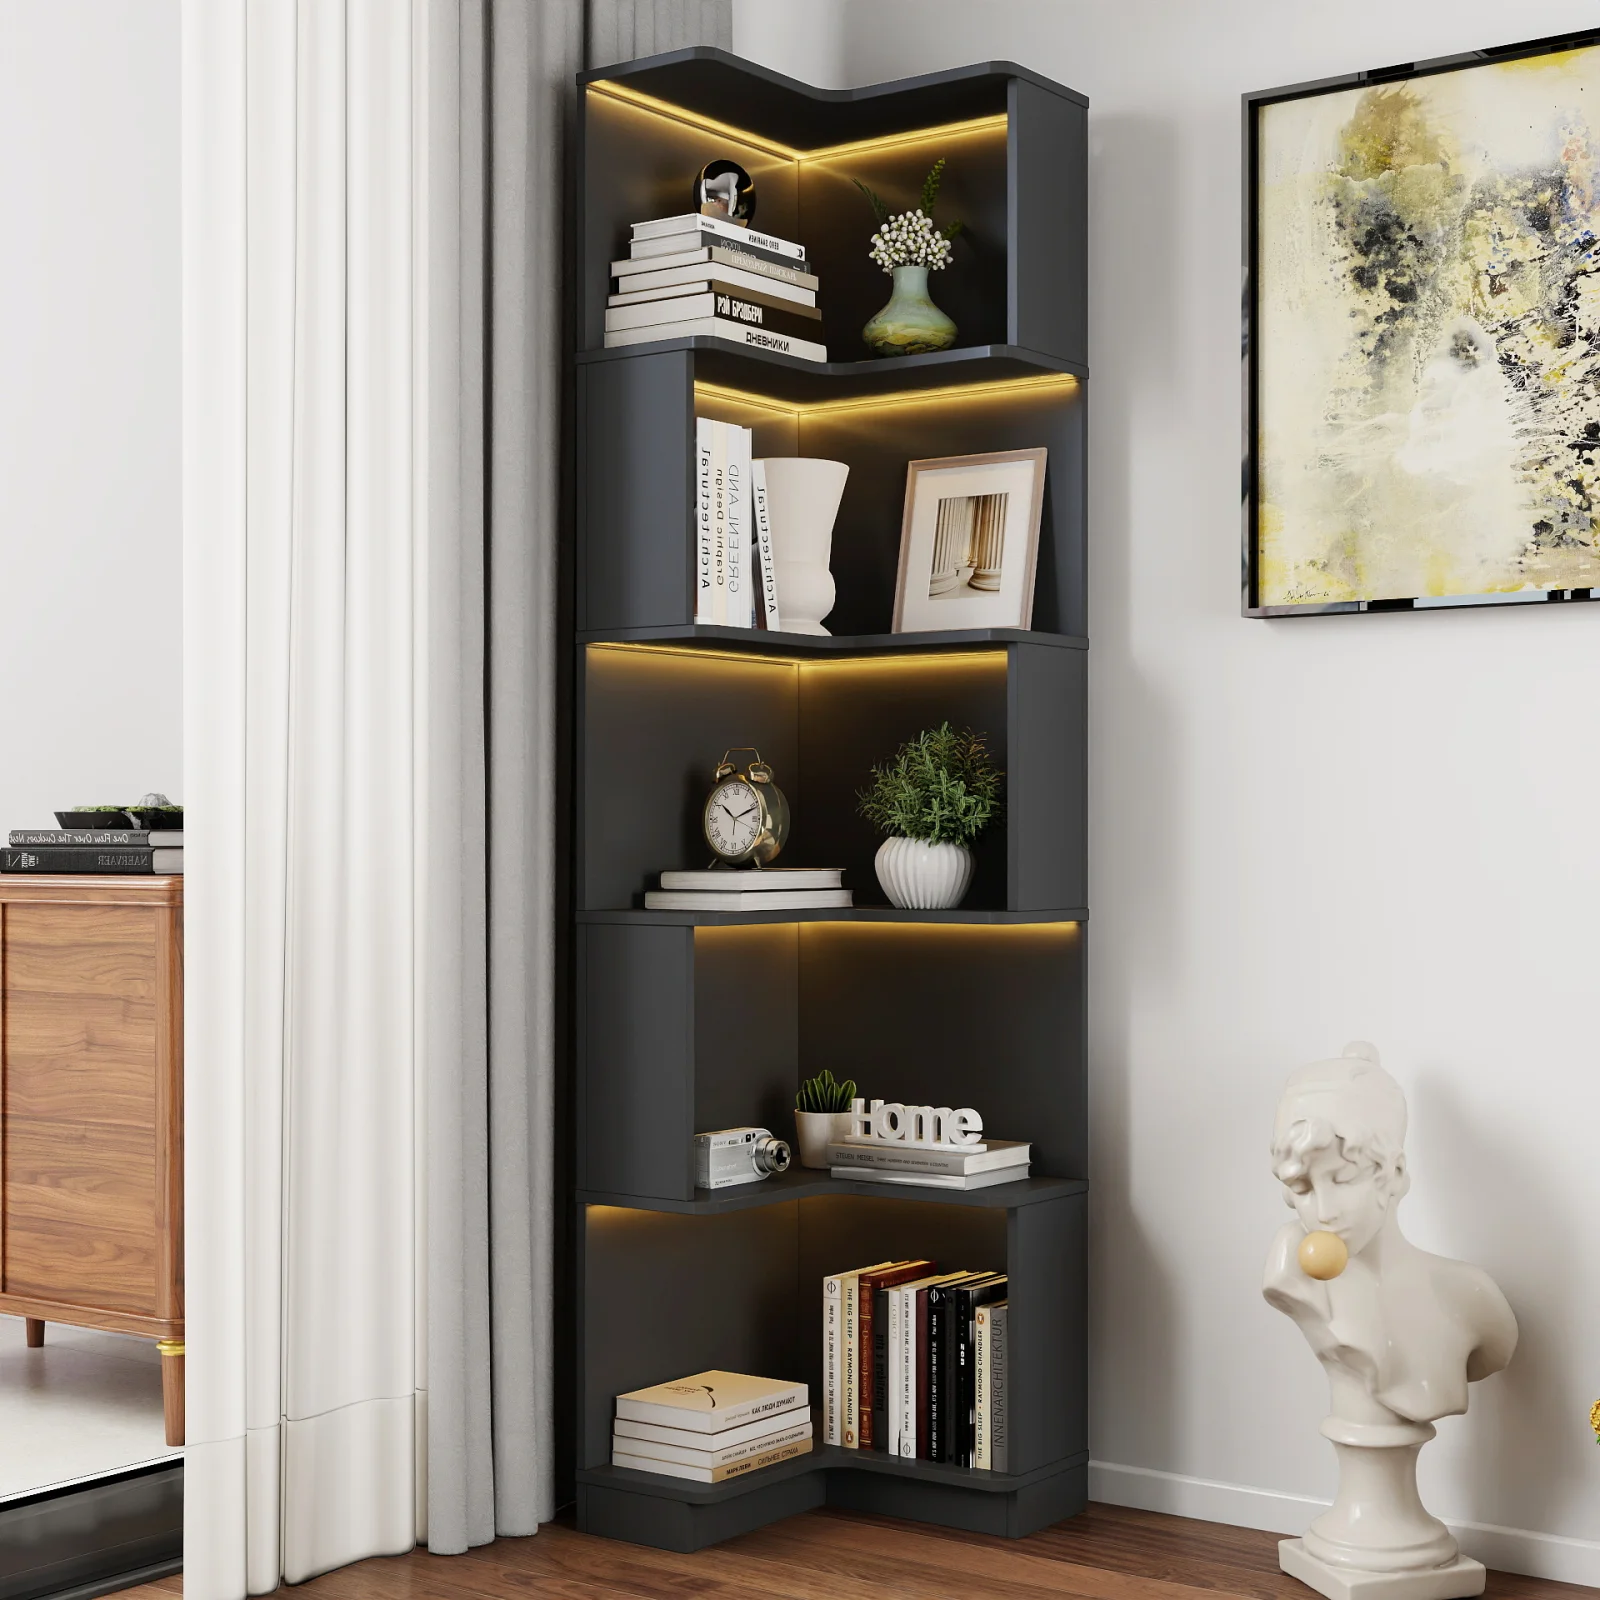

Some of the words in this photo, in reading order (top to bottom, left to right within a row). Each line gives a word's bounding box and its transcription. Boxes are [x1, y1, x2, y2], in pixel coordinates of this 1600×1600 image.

[718, 295, 730, 315] РЭЙ
[732, 300, 763, 324] БРЭДБЕРИ
[746, 332, 790, 352] ДНЕВНИКИ
[851, 1098, 983, 1145] Home
[856, 1154, 875, 1162] MEISEL
[992, 1319, 1005, 1448] INNENARCHITEKTUR
[752, 1407, 761, 1415] КАК
[726, 1465, 739, 1475] МАРК
[758, 1453, 780, 1466] СИЛЬНЕЕ
[782, 1447, 799, 1458] СТРАХА
